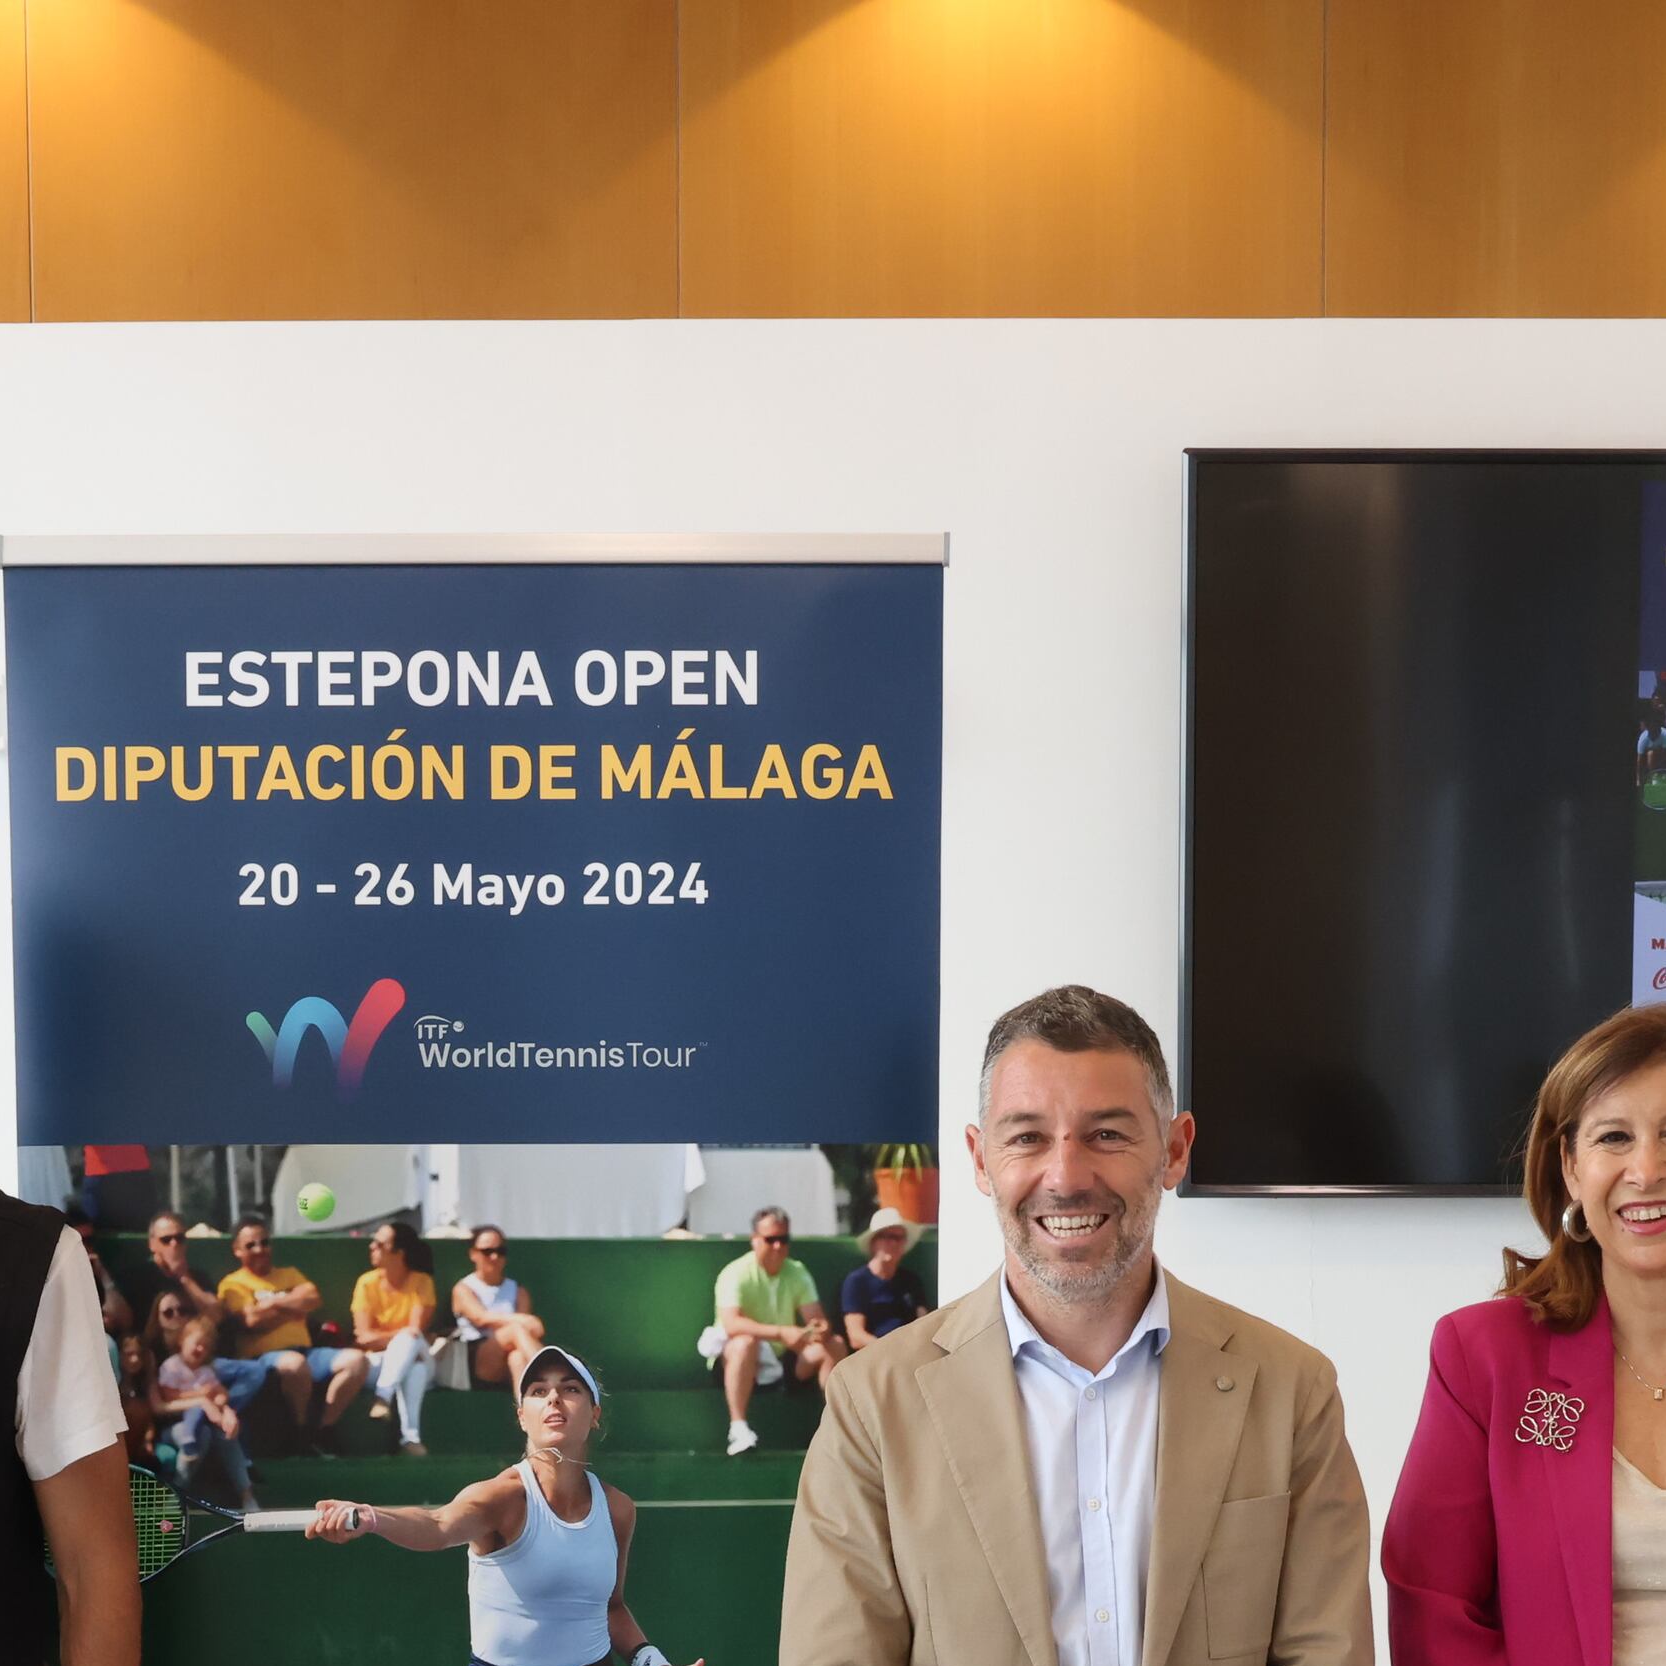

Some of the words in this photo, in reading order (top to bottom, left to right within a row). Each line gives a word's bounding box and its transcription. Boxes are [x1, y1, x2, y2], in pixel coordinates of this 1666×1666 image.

[184, 649, 553, 708] ESTEPONA
[574, 649, 758, 707] OPEN
[54, 728, 465, 802] DIPUTACIÓN
[490, 743, 577, 801] DE
[600, 727, 894, 801] MÁLAGA
[238, 863, 300, 906] 20
[316, 884, 337, 894] -
[354, 863, 416, 906] 26
[434, 863, 566, 916] Mayo
[582, 862, 709, 905] 2024
[416, 1023, 449, 1040] ITF
[418, 1040, 697, 1069] WorldTennisTour
